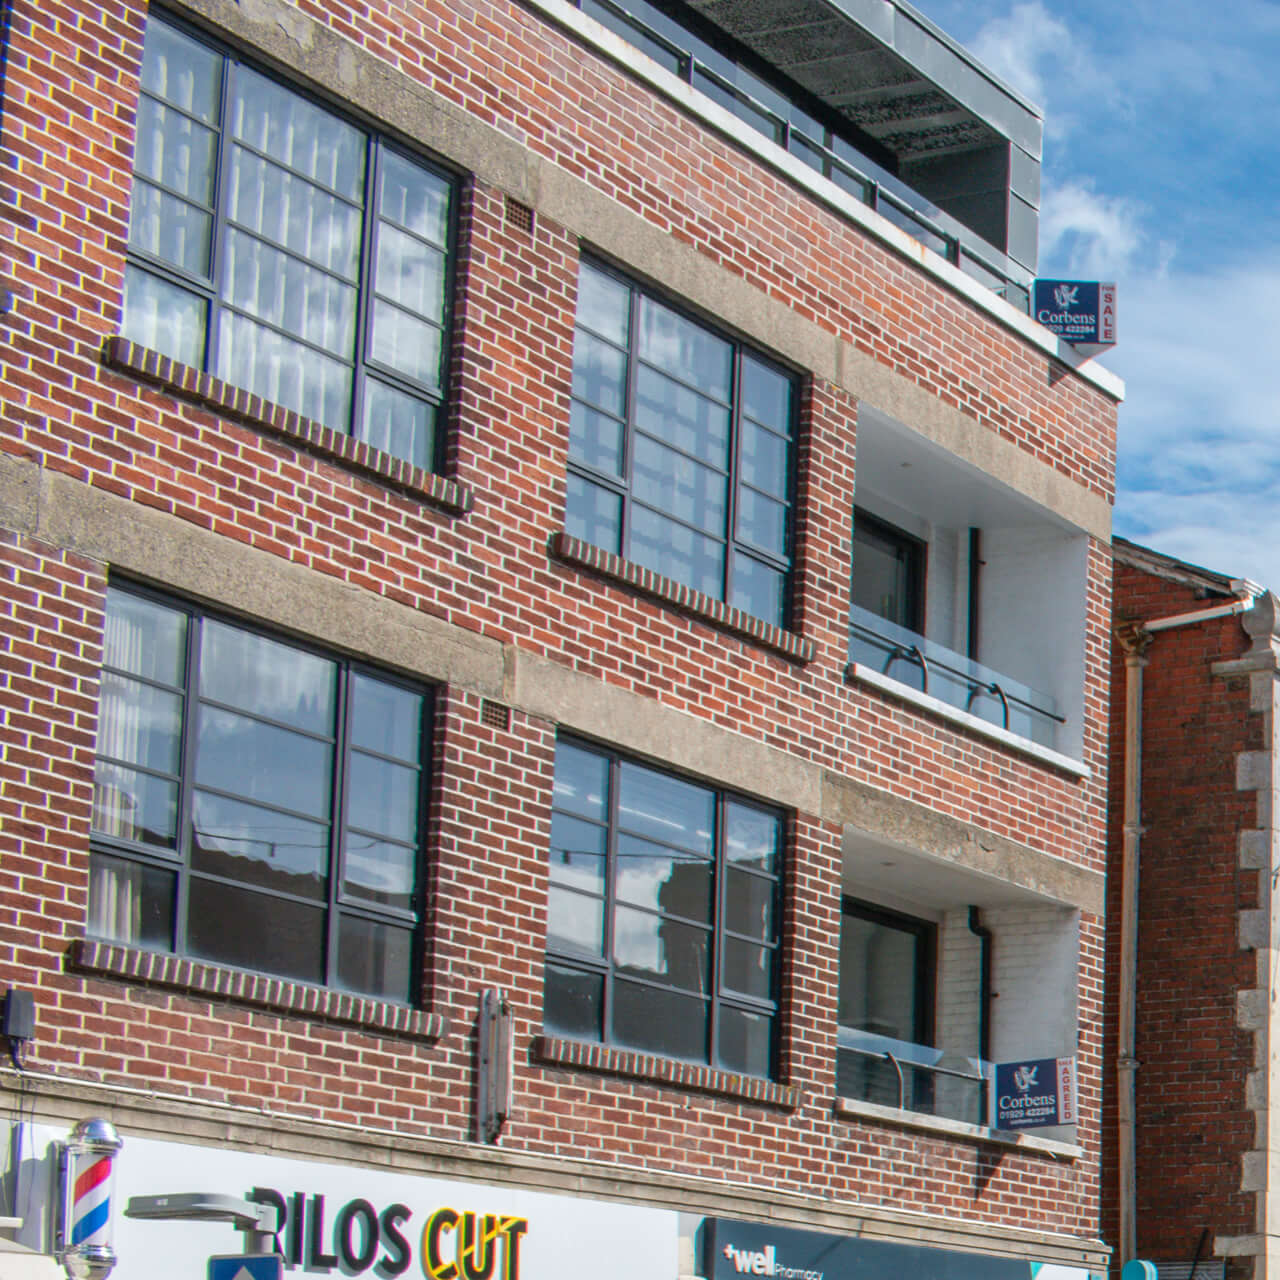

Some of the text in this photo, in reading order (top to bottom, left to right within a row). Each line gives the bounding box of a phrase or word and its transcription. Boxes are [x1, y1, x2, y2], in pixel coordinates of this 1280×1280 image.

[1039, 310, 1096, 325] Corbens
[1103, 293, 1113, 339] SALE
[999, 1094, 1056, 1110] Corbens
[1062, 1067, 1072, 1119] AGREED
[733, 1245, 776, 1275] well
